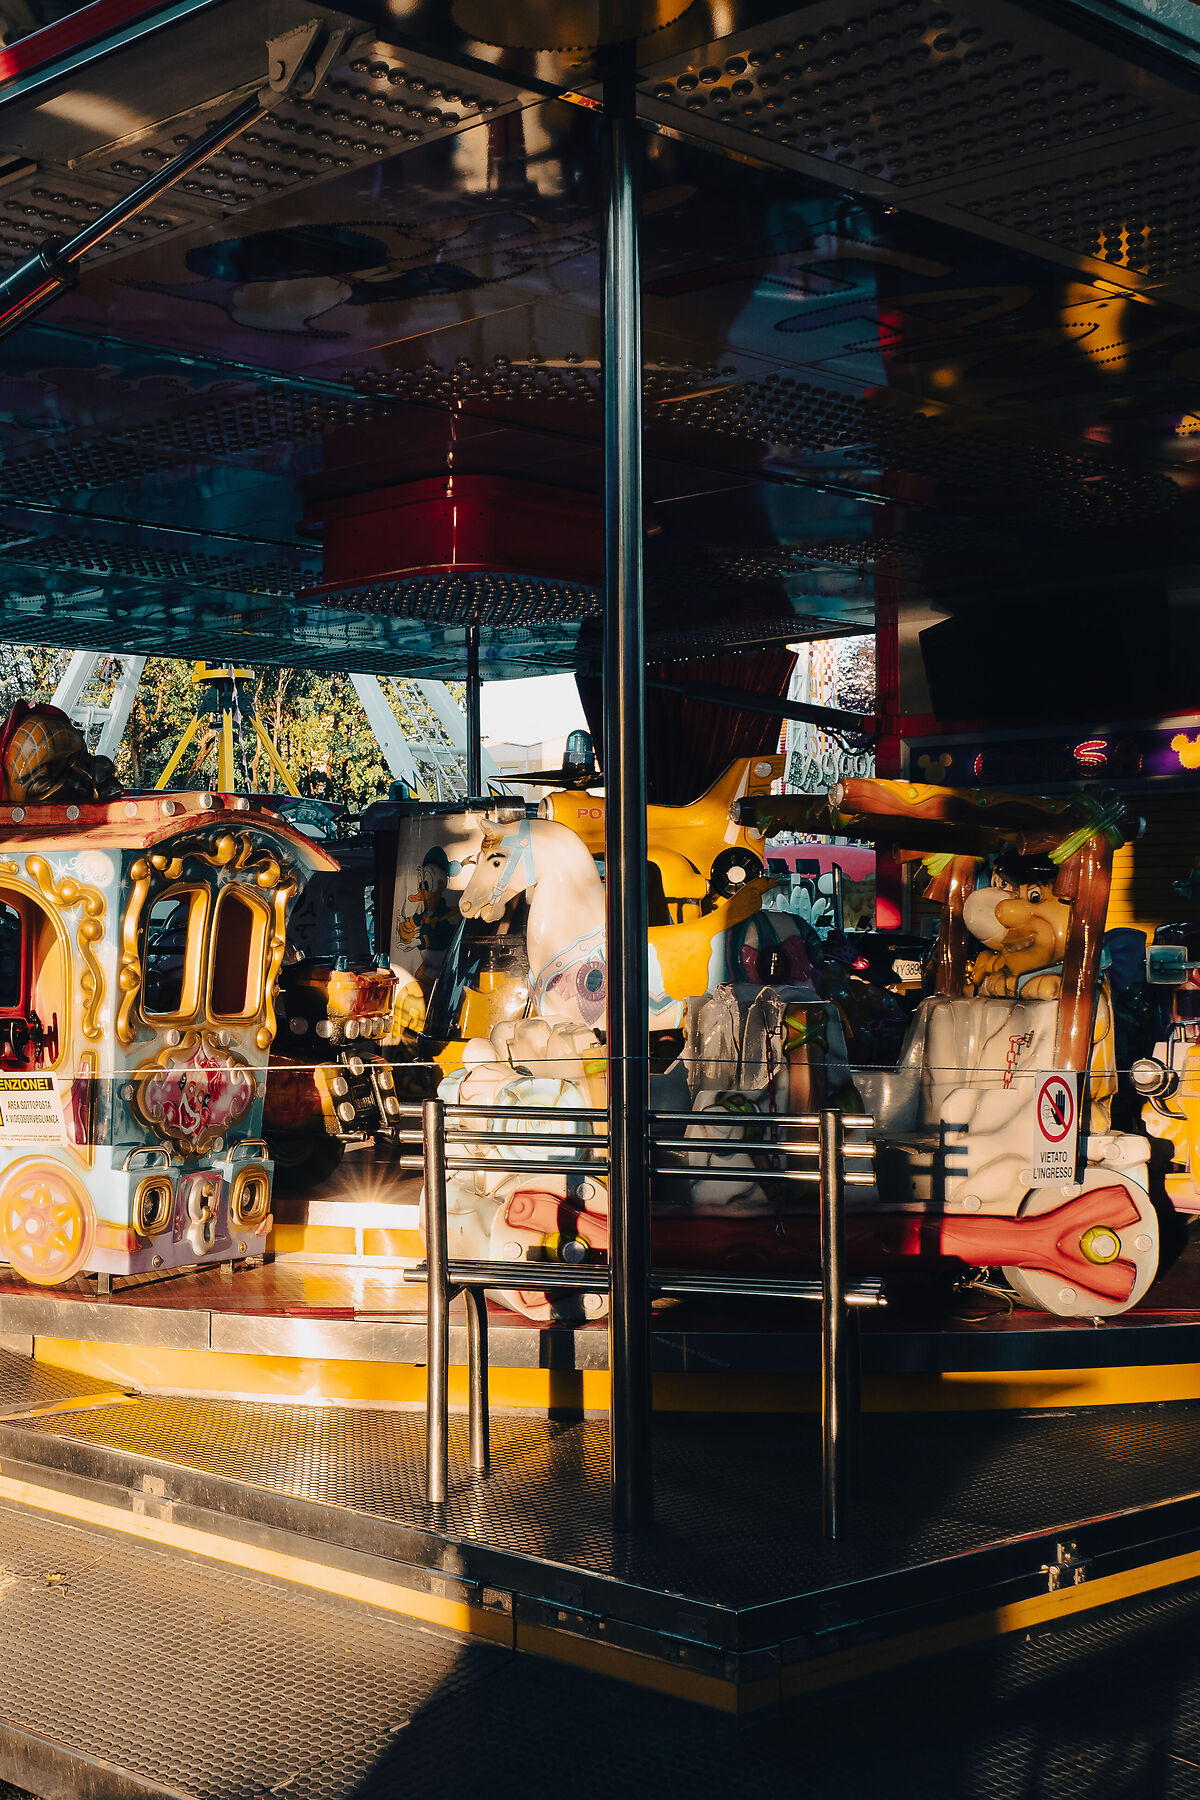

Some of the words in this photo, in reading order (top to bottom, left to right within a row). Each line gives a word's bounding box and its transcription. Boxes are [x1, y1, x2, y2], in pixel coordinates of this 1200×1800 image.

[7, 1100, 20, 1110] AREA
[20, 1100, 51, 1110] SOTTOPOSTA
[9, 1114, 59, 1124] VIDEOSORVEGLIANZA
[1040, 1151, 1068, 1163] VIETATO
[1033, 1166, 1073, 1180] L'INGRESSO
